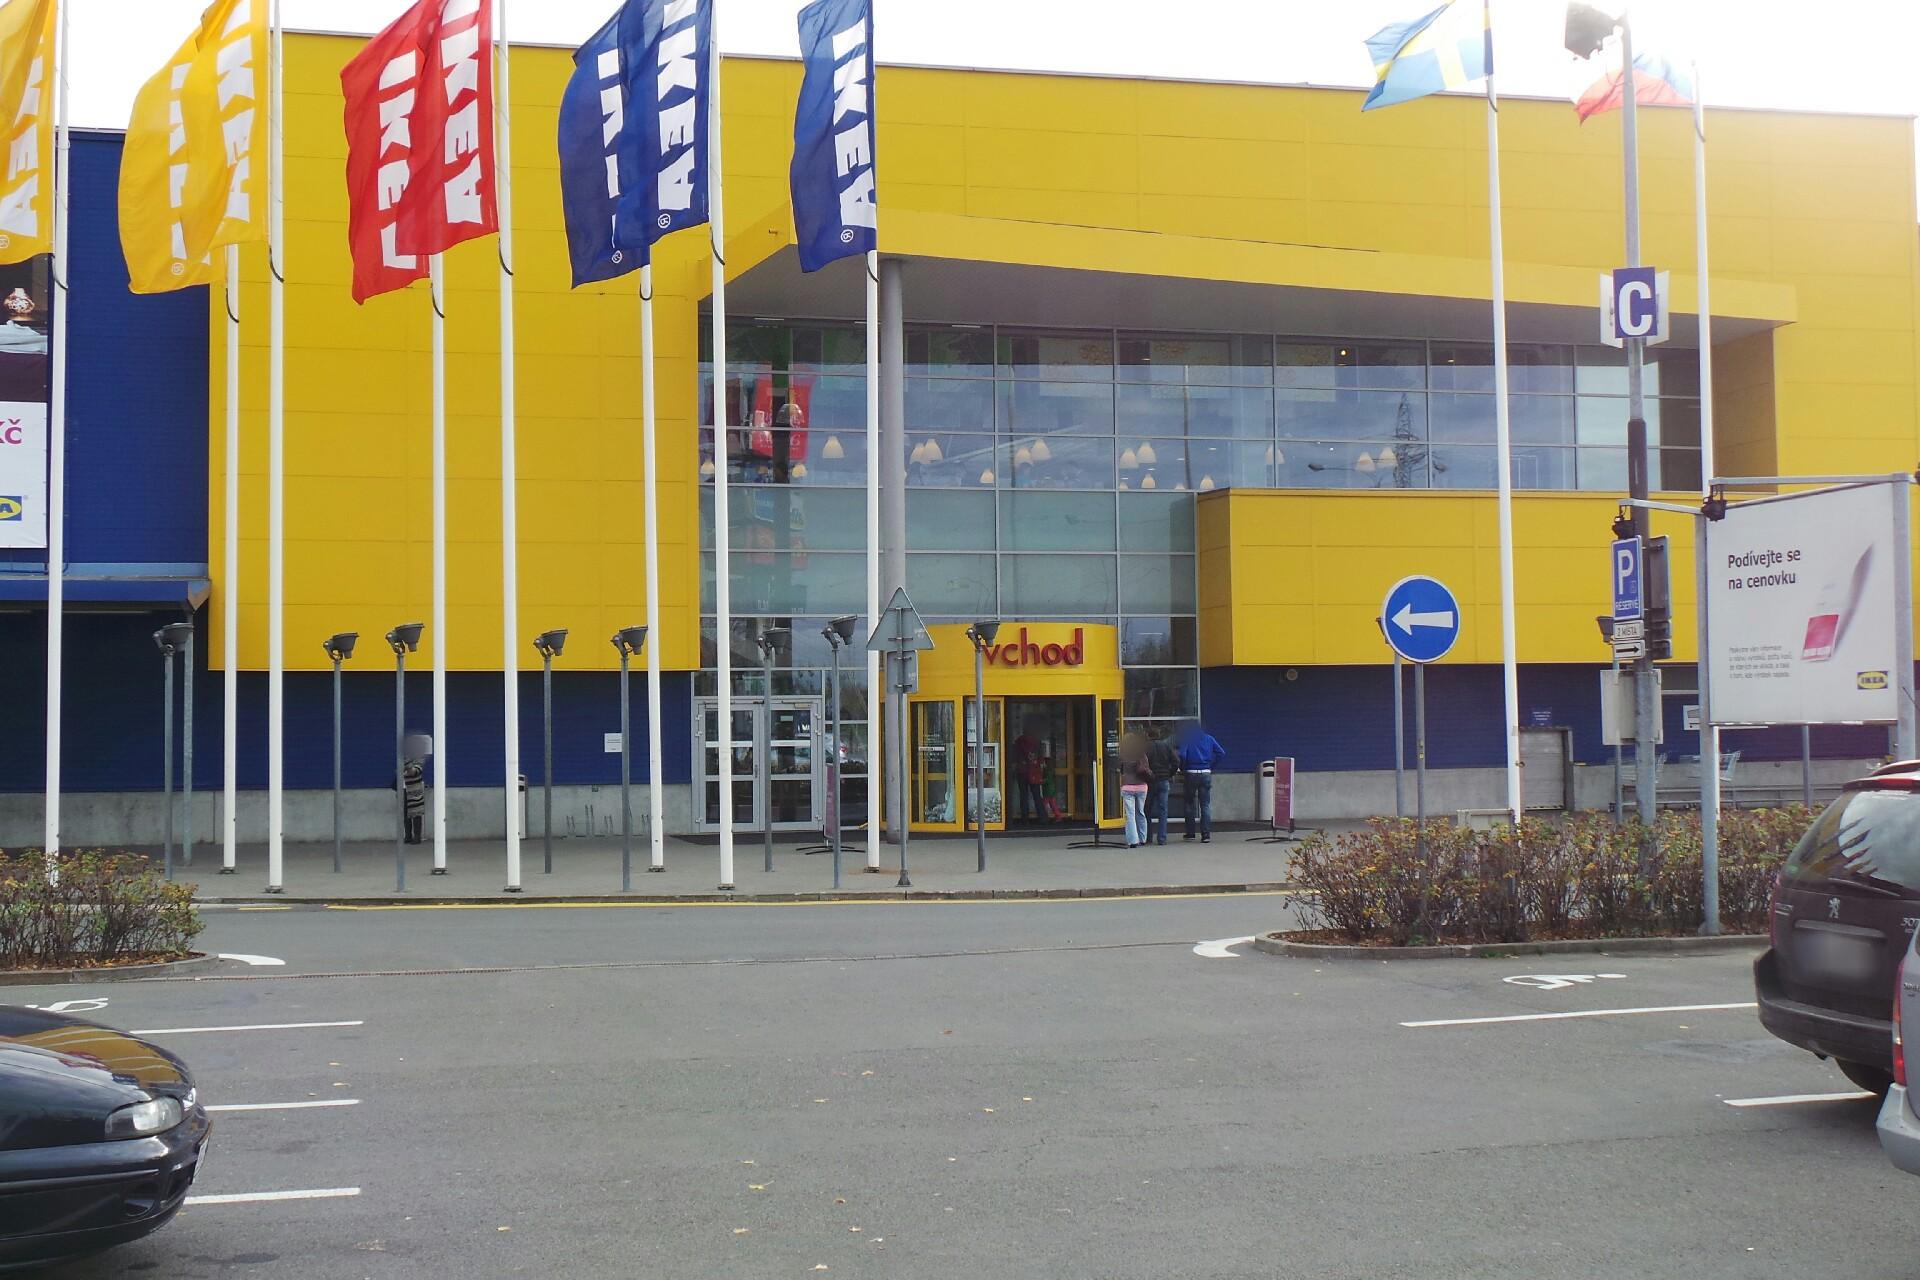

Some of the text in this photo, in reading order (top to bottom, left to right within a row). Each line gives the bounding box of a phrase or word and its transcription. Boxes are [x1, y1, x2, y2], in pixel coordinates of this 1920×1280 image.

[440, 0, 483, 225] IKEA
[656, 0, 698, 211] IKEA
[832, 15, 877, 229] IKEA
[0, 34, 45, 238] KEA
[1618, 280, 1653, 336] C
[1617, 549, 1634, 595] P
[1728, 550, 1801, 568] Podívejte se
[1728, 570, 1796, 590] na cenovku
[981, 627, 1084, 666] vchod
